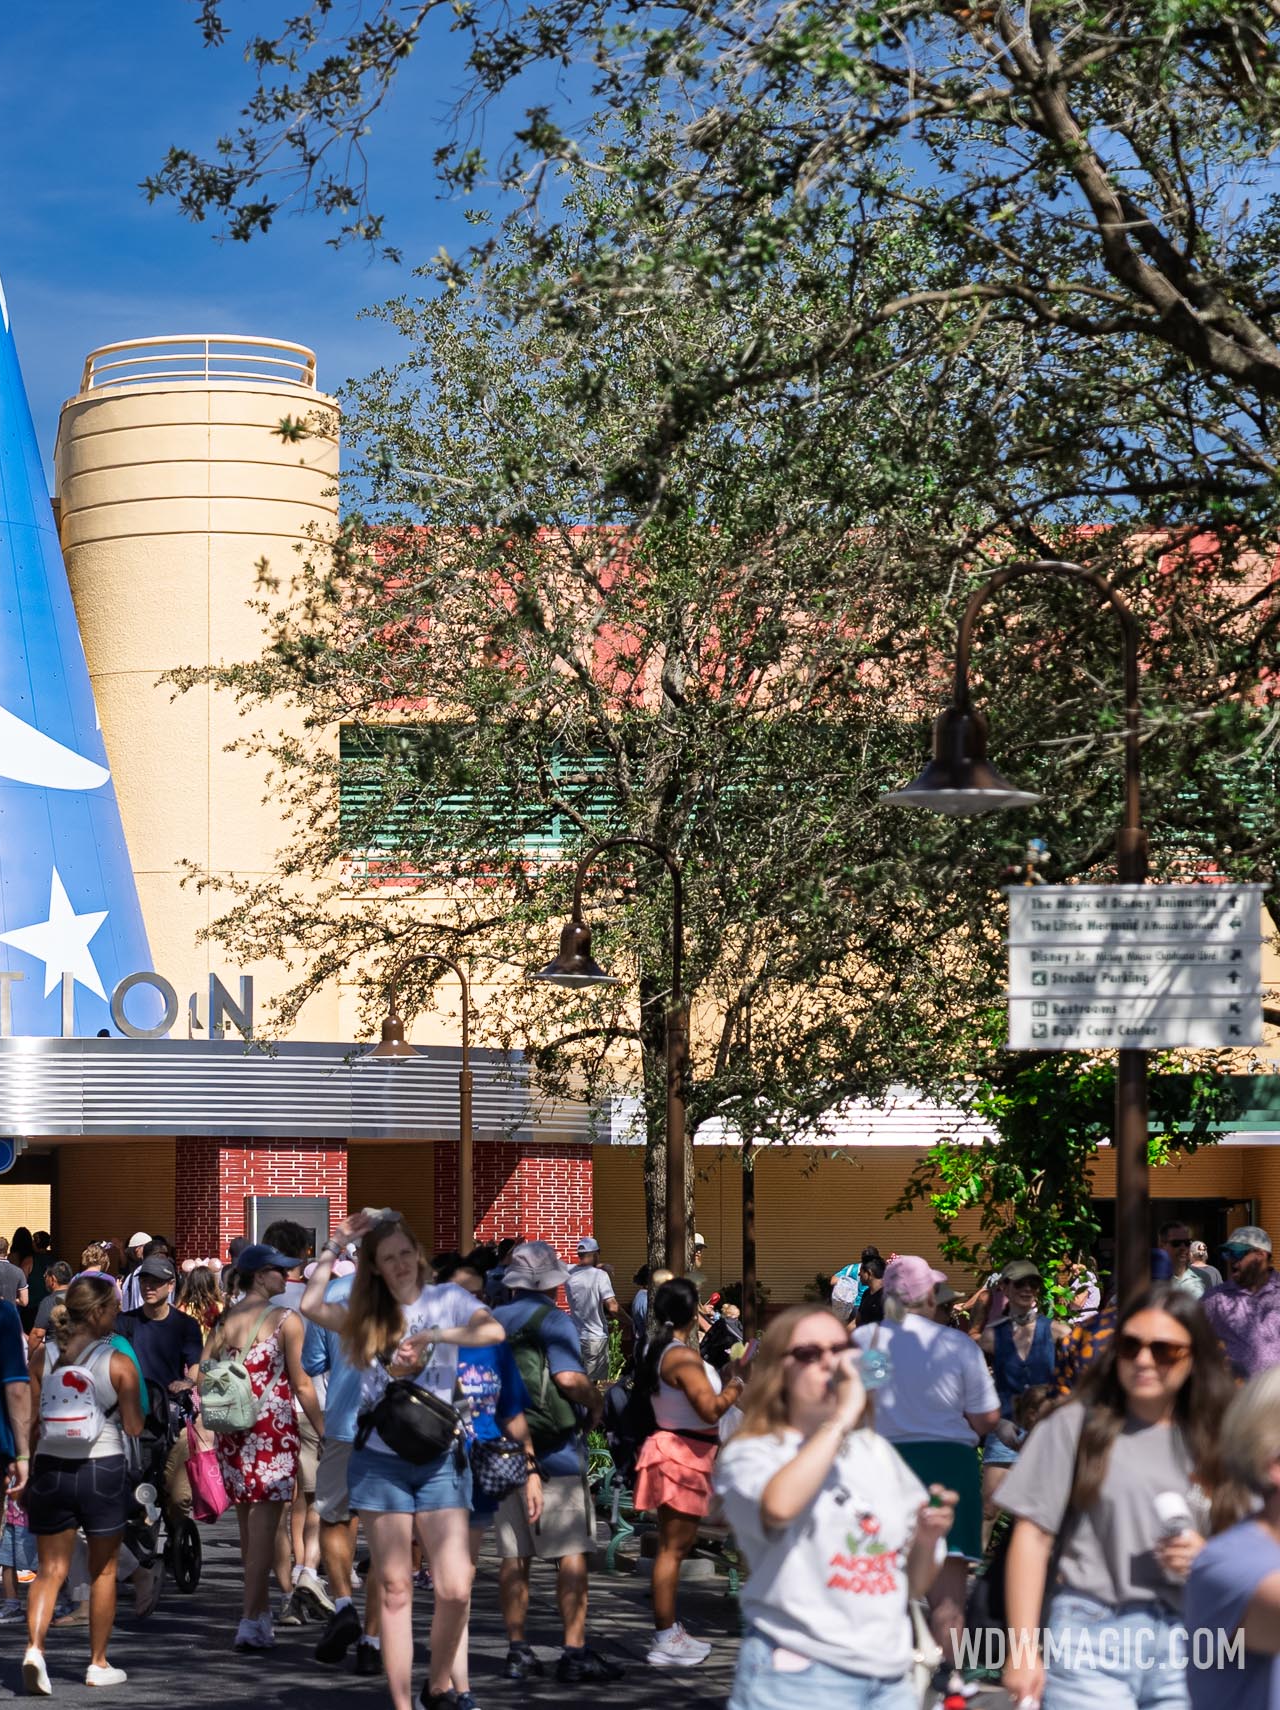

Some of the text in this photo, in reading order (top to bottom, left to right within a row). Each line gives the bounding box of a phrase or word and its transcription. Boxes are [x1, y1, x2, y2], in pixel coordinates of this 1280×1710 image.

[1031, 895, 1217, 911] The Magic of Disney Animation
[1031, 919, 1050, 931] The
[1053, 919, 1082, 931] Little
[1087, 918, 1138, 931] Mermaid
[1031, 950, 1069, 964] Disney
[1051, 971, 1149, 986] Stroller Parking
[1052, 1003, 1117, 1015] Restrooms
[1052, 1024, 1157, 1038] Baby Care Center
